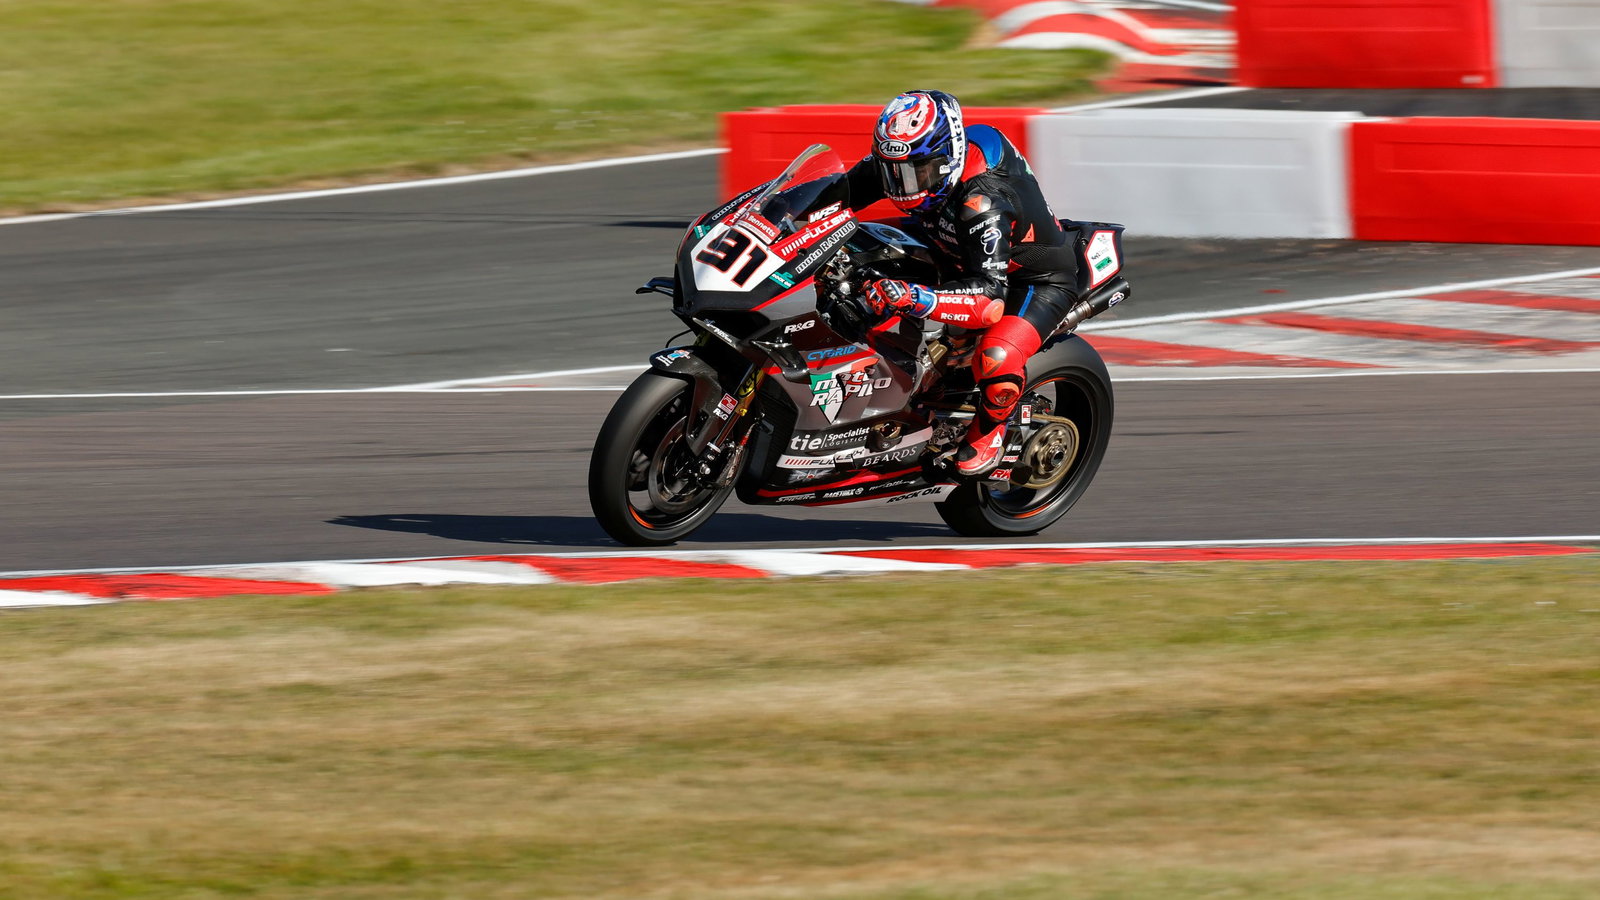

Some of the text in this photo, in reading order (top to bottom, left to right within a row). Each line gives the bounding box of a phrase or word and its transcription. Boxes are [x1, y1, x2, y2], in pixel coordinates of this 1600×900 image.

[881, 143, 905, 152] Arai
[809, 202, 841, 223] WRS
[747, 215, 776, 237] Bennetts
[801, 209, 852, 243] FULLSIX
[795, 220, 856, 274] moto RAPIDO
[695, 227, 769, 288] 91
[938, 296, 976, 306] ROCK OIL
[940, 312, 970, 322] ROKIT
[783, 319, 816, 335] R&G
[807, 345, 857, 361] CYBRID
[712, 407, 729, 421] R&G
[790, 426, 871, 451] tie Specialist
[824, 435, 868, 448] LOGISTICS
[862, 446, 918, 467] BEARDS
[886, 486, 942, 504] ROCK OIL
